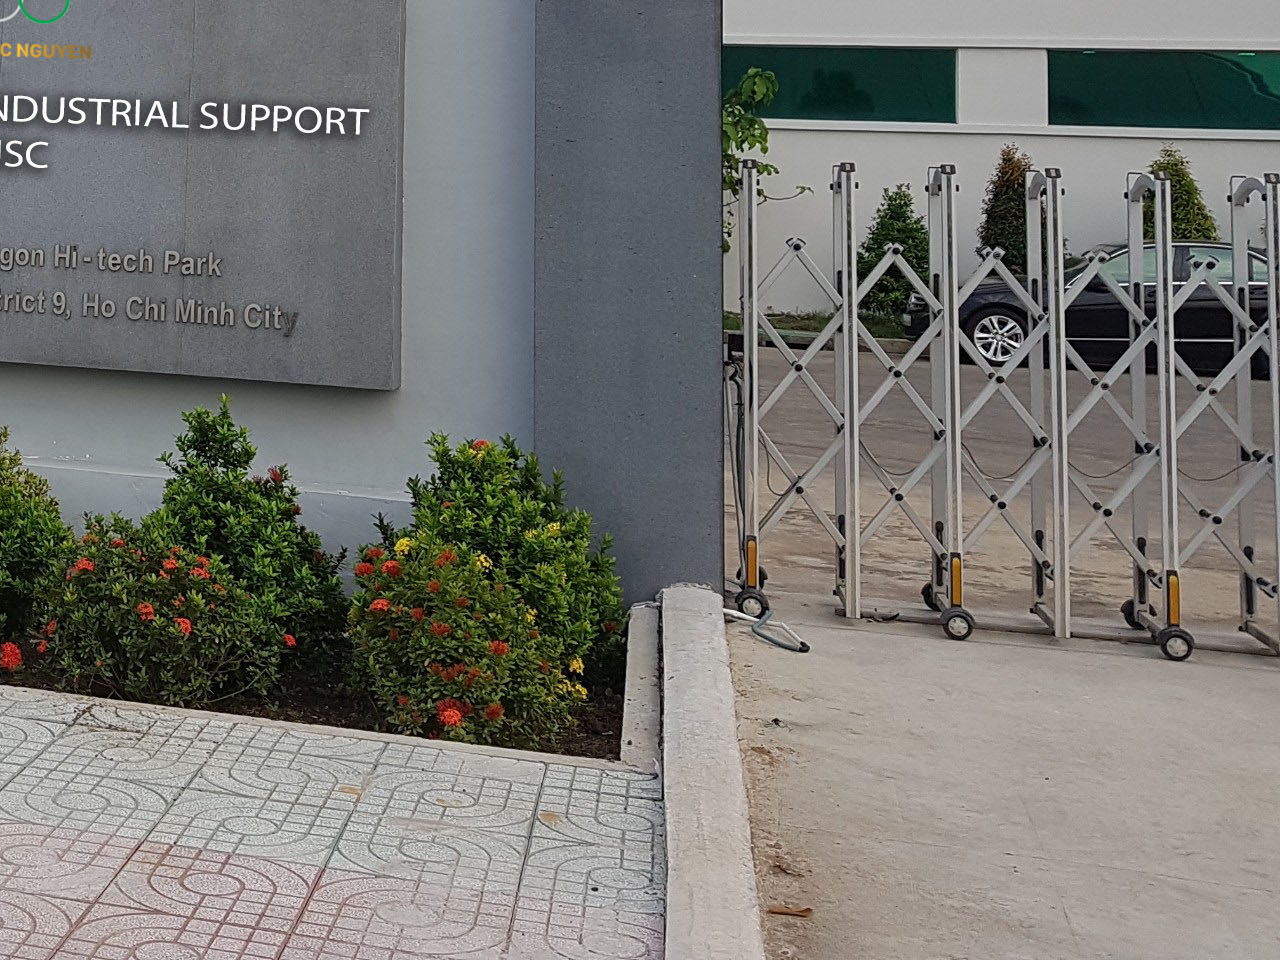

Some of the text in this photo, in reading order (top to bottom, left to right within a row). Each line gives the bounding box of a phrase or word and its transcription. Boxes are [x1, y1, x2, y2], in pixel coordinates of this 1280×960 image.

[16, 43, 92, 59] NGUYEN
[199, 101, 371, 137] SUPPORT
[163, 249, 223, 277] Park
[52, 290, 72, 320] 9,
[81, 293, 116, 319] Ho
[125, 296, 166, 323] Chi
[174, 298, 235, 327] Minh
